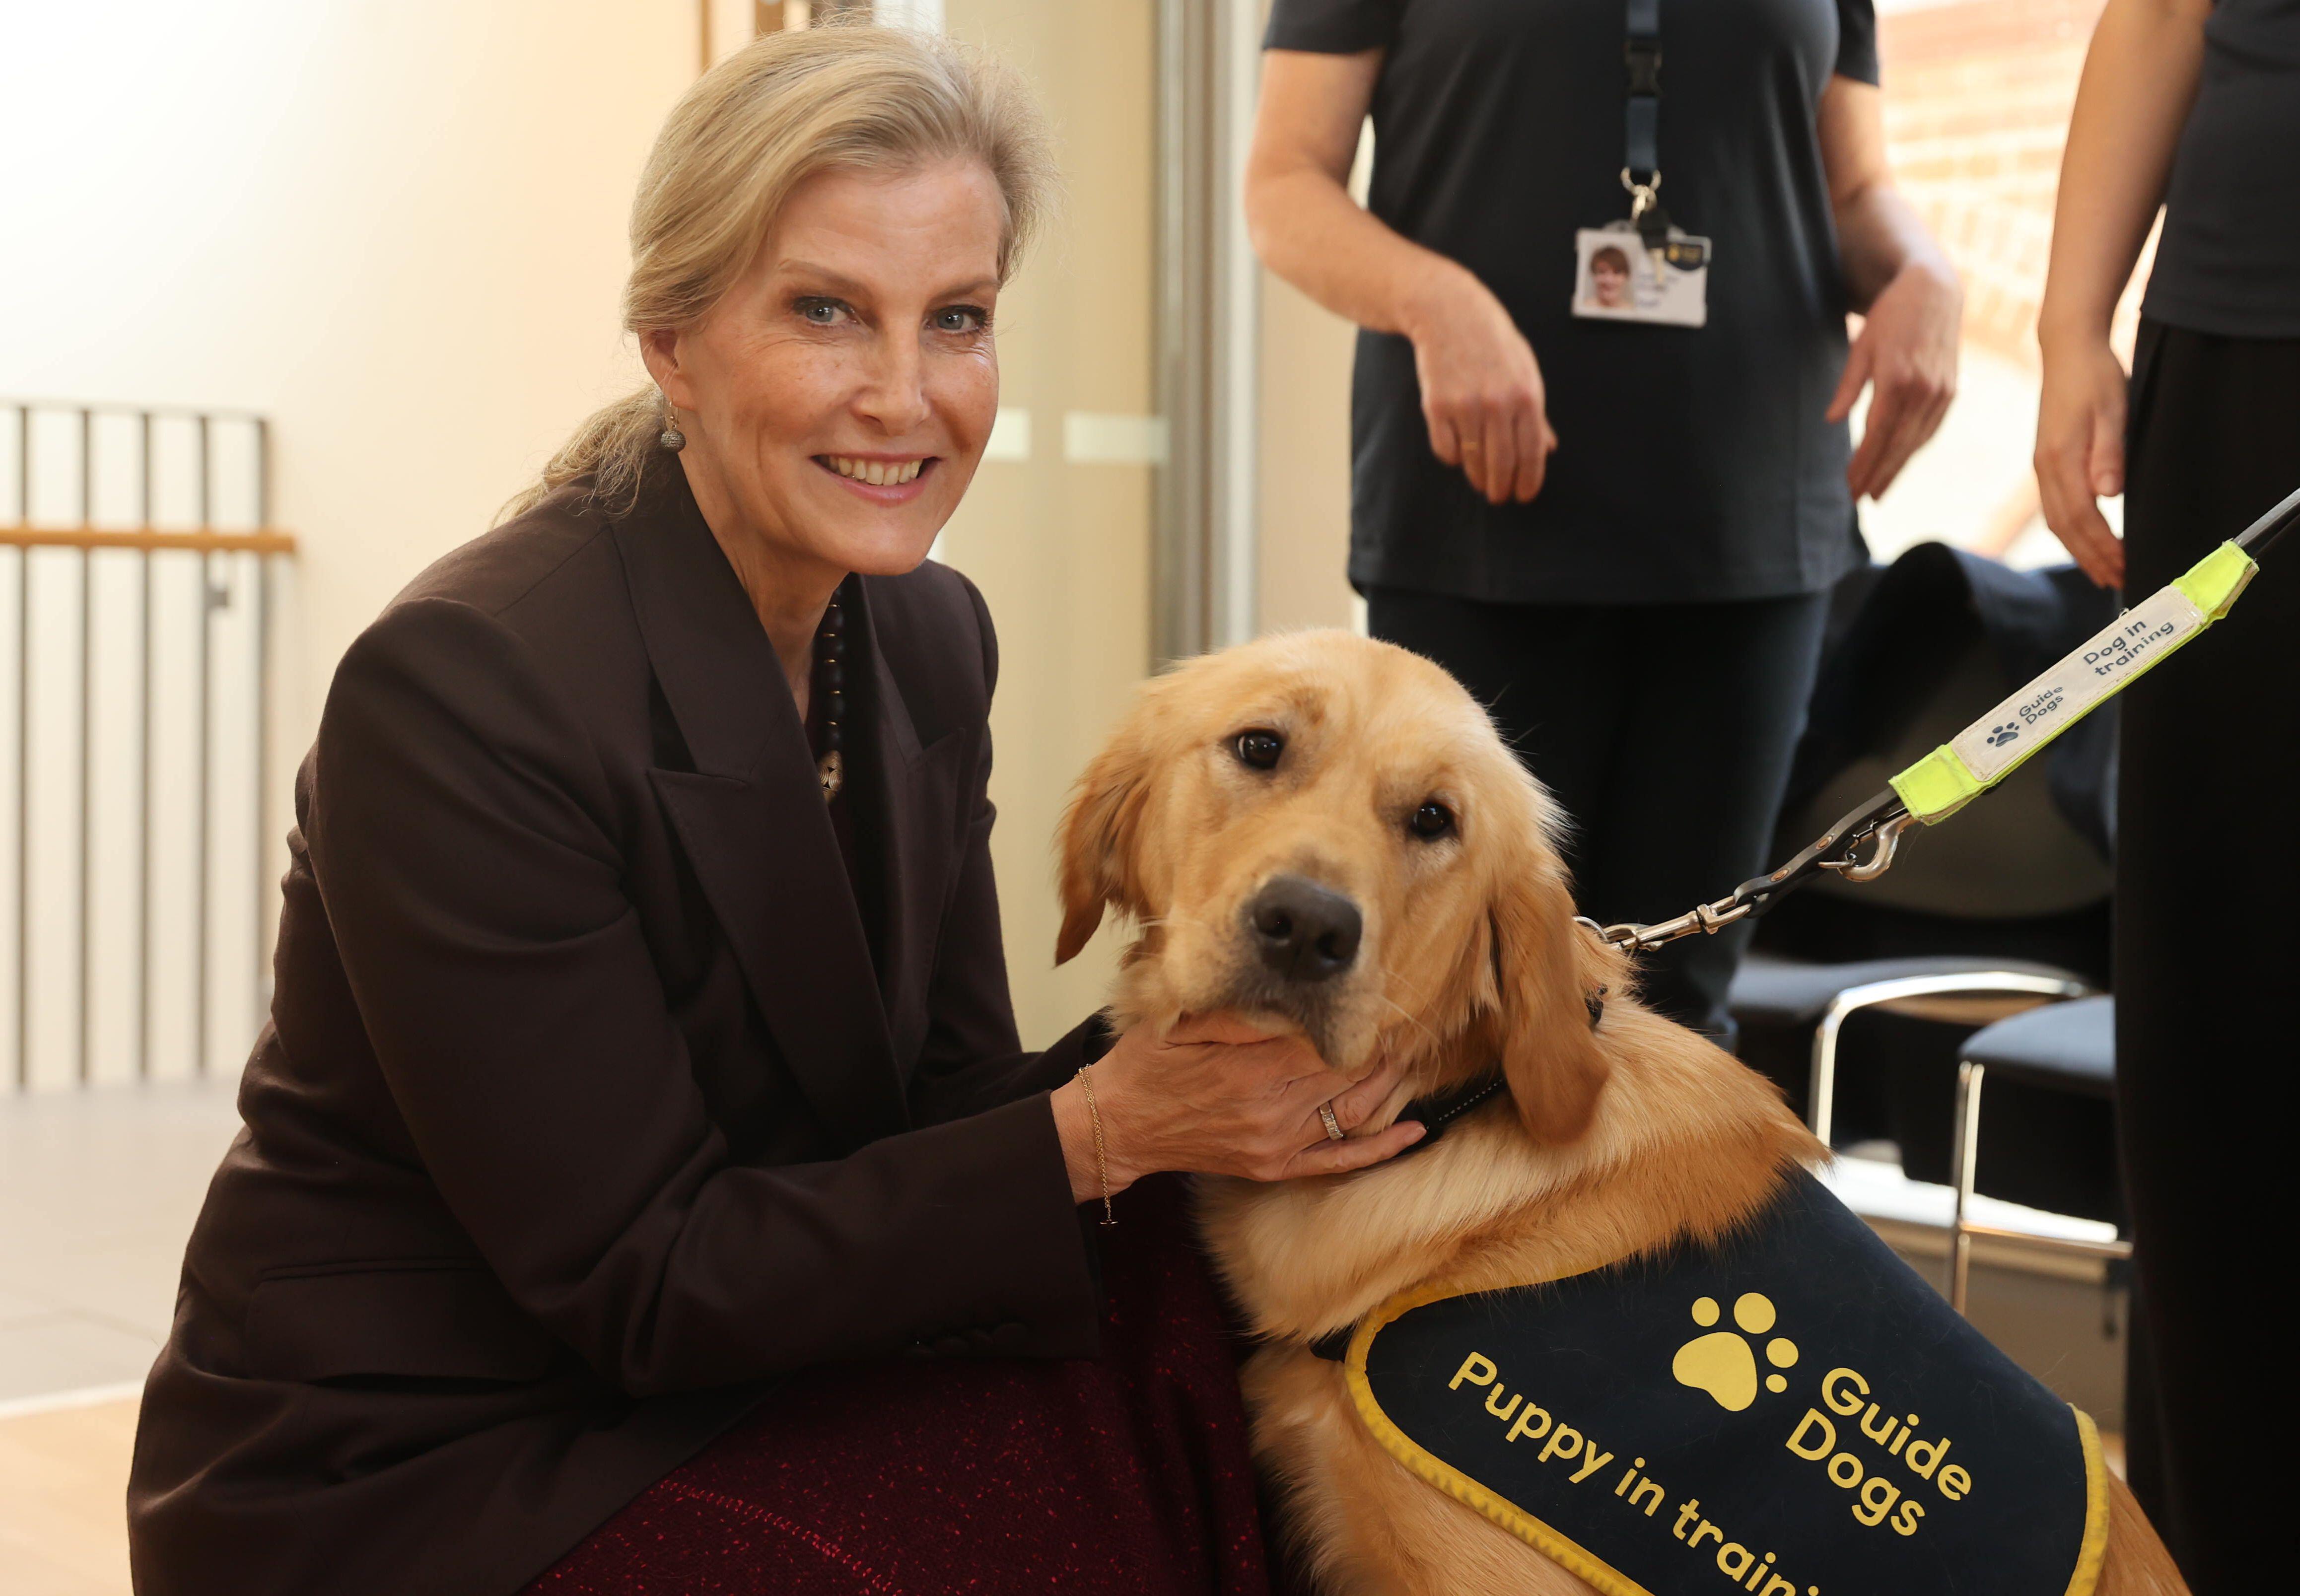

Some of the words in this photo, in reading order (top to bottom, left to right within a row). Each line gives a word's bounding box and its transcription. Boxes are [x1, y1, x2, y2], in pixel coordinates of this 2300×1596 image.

[2083, 636, 2127, 665] Dog
[2124, 621, 2147, 637] in
[2094, 621, 2174, 676] training
[2019, 686, 2063, 717] Guide
[2025, 695, 2064, 725] Dogs
[1821, 1367, 1972, 1501] Guide
[1448, 1351, 1614, 1484] Puppy
[1614, 1457, 1665, 1517] in
[1673, 1498, 1819, 1596] train
[1785, 1407, 1925, 1536] Dogs
